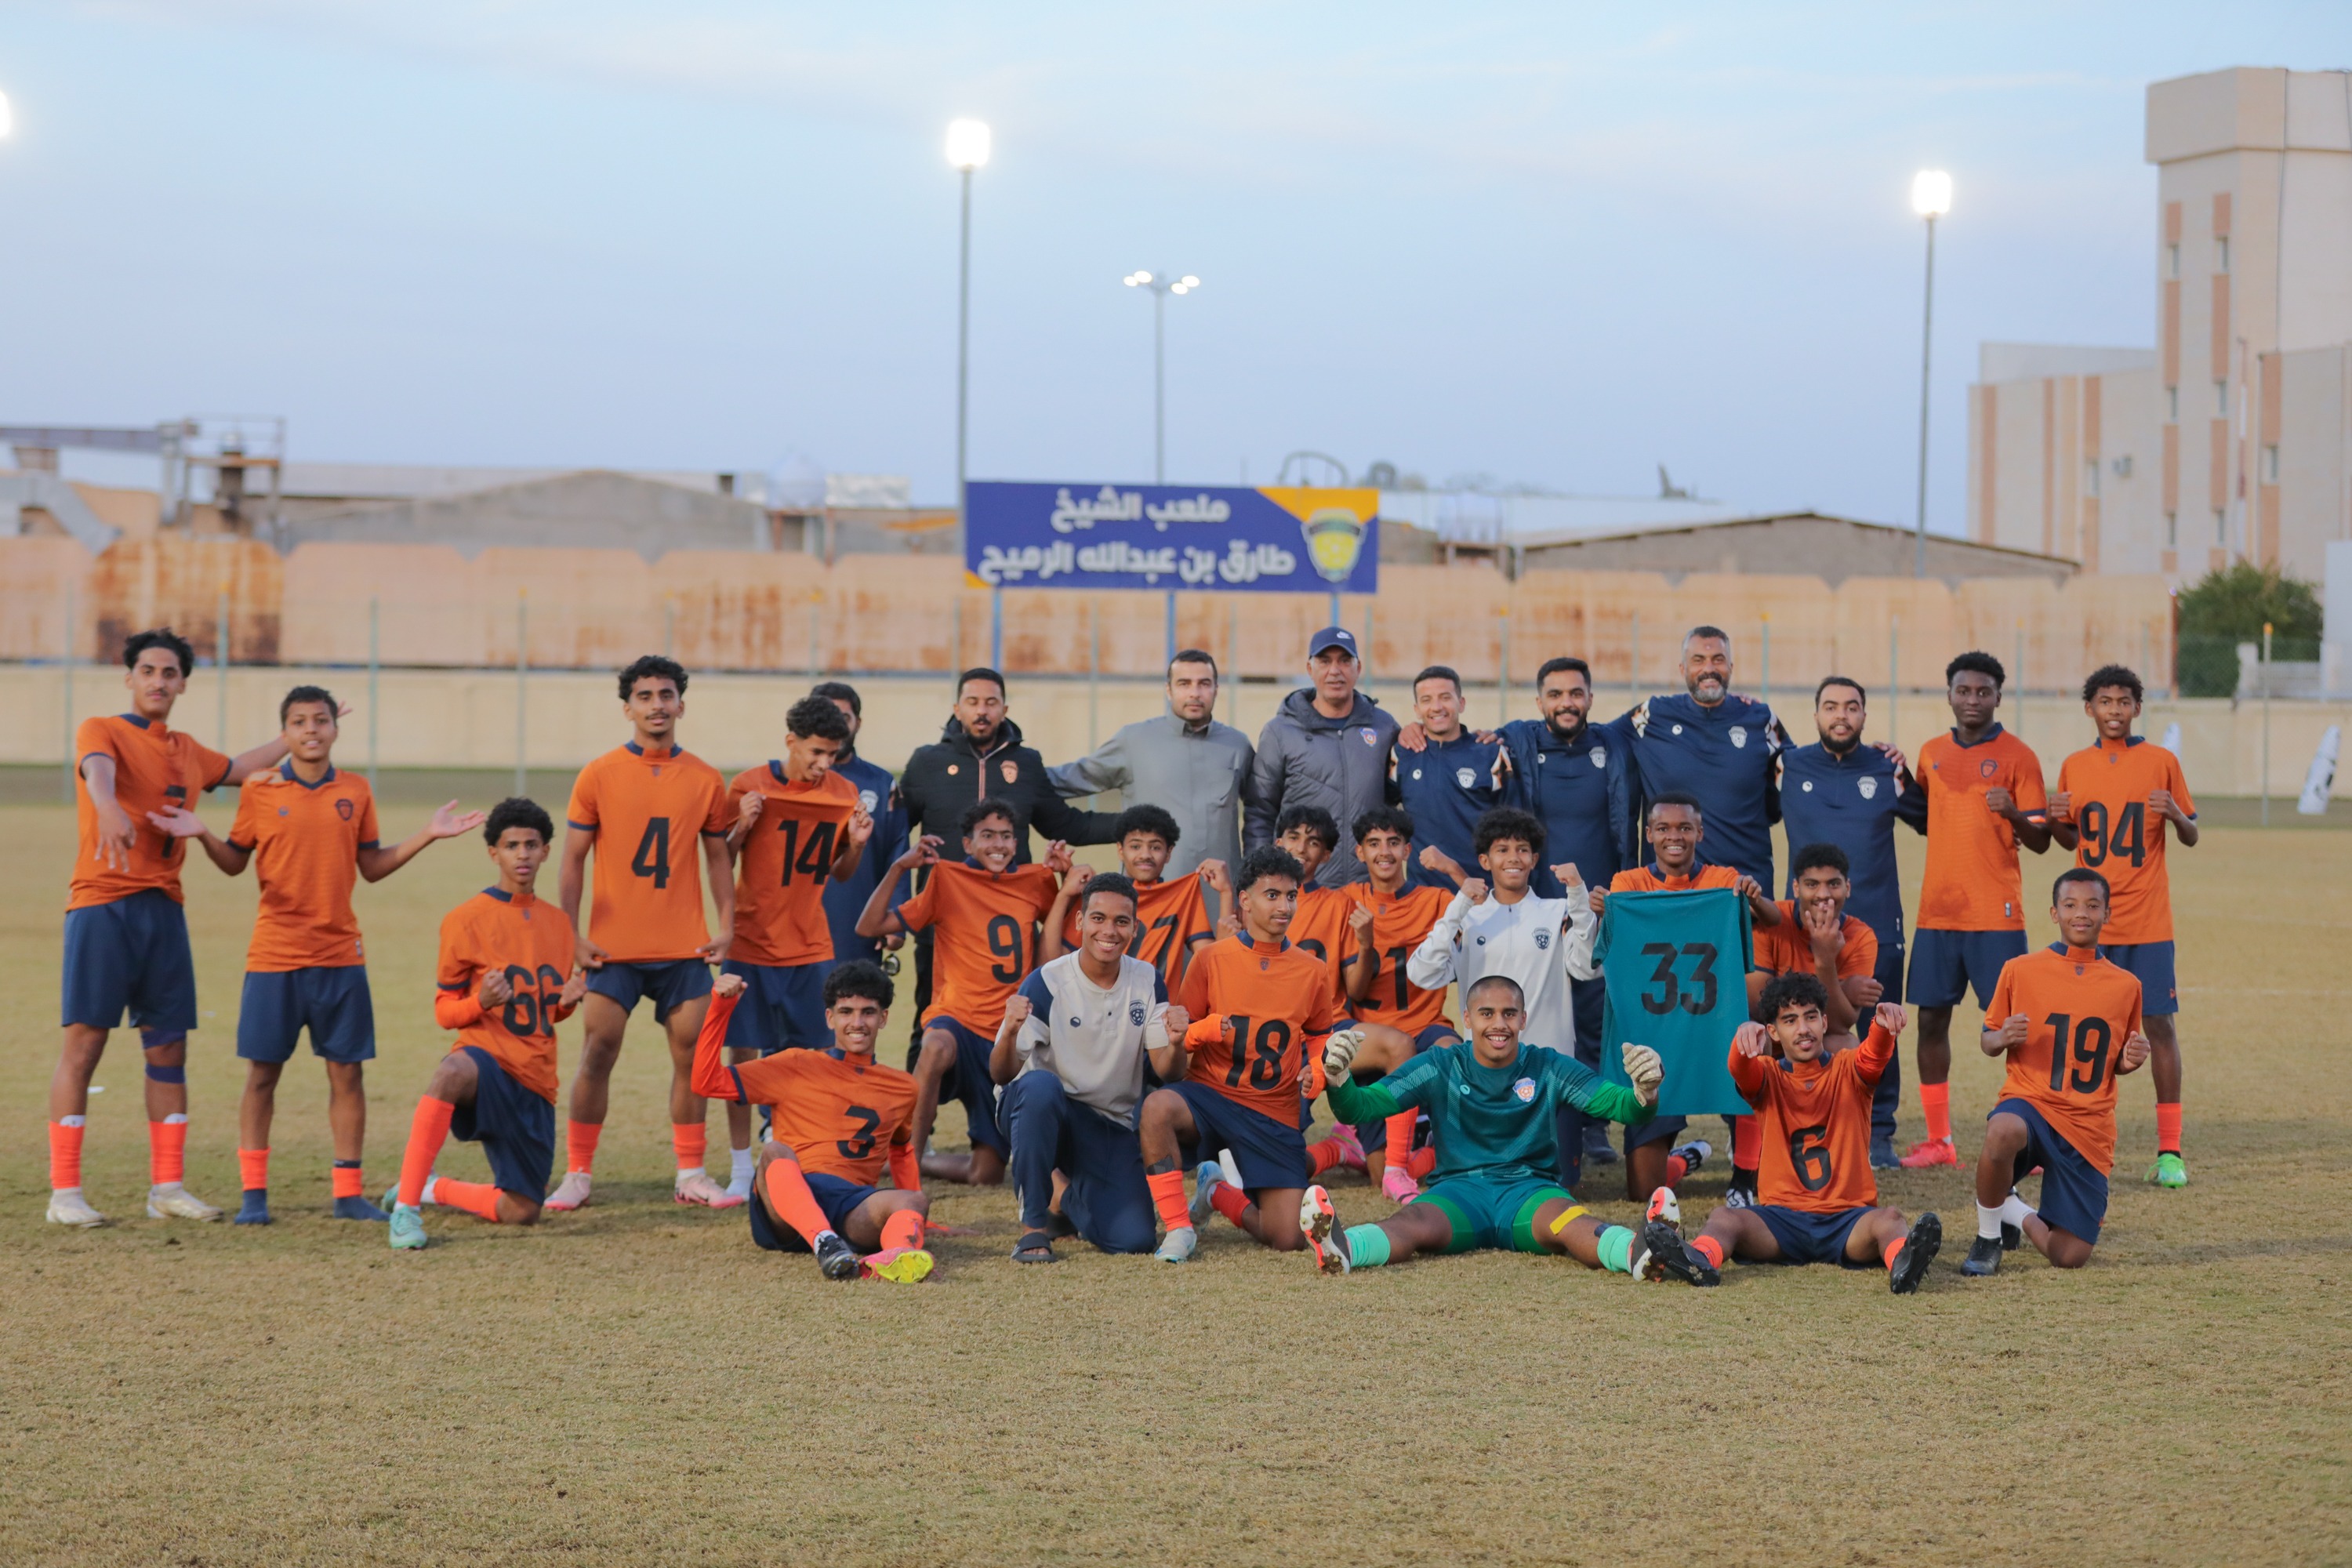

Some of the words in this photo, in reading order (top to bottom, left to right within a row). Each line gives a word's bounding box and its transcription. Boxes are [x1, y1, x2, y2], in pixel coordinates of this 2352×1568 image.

[1050, 485, 1143, 534] الشيخ
[1145, 493, 1232, 532] ملعب
[978, 539, 1075, 586] الرميح
[1178, 546, 1217, 585] بن
[1218, 539, 1297, 583] طارق
[631, 817, 670, 889] 4
[777, 819, 837, 887] 14
[2080, 801, 2146, 868] 94
[987, 914, 1023, 985] 9
[1641, 942, 1719, 1015] 33
[503, 964, 565, 1038] 66
[1225, 1014, 1291, 1091] 18
[2045, 1013, 2111, 1094] 19
[837, 1105, 881, 1160] 3
[1791, 1125, 1832, 1191] 6
